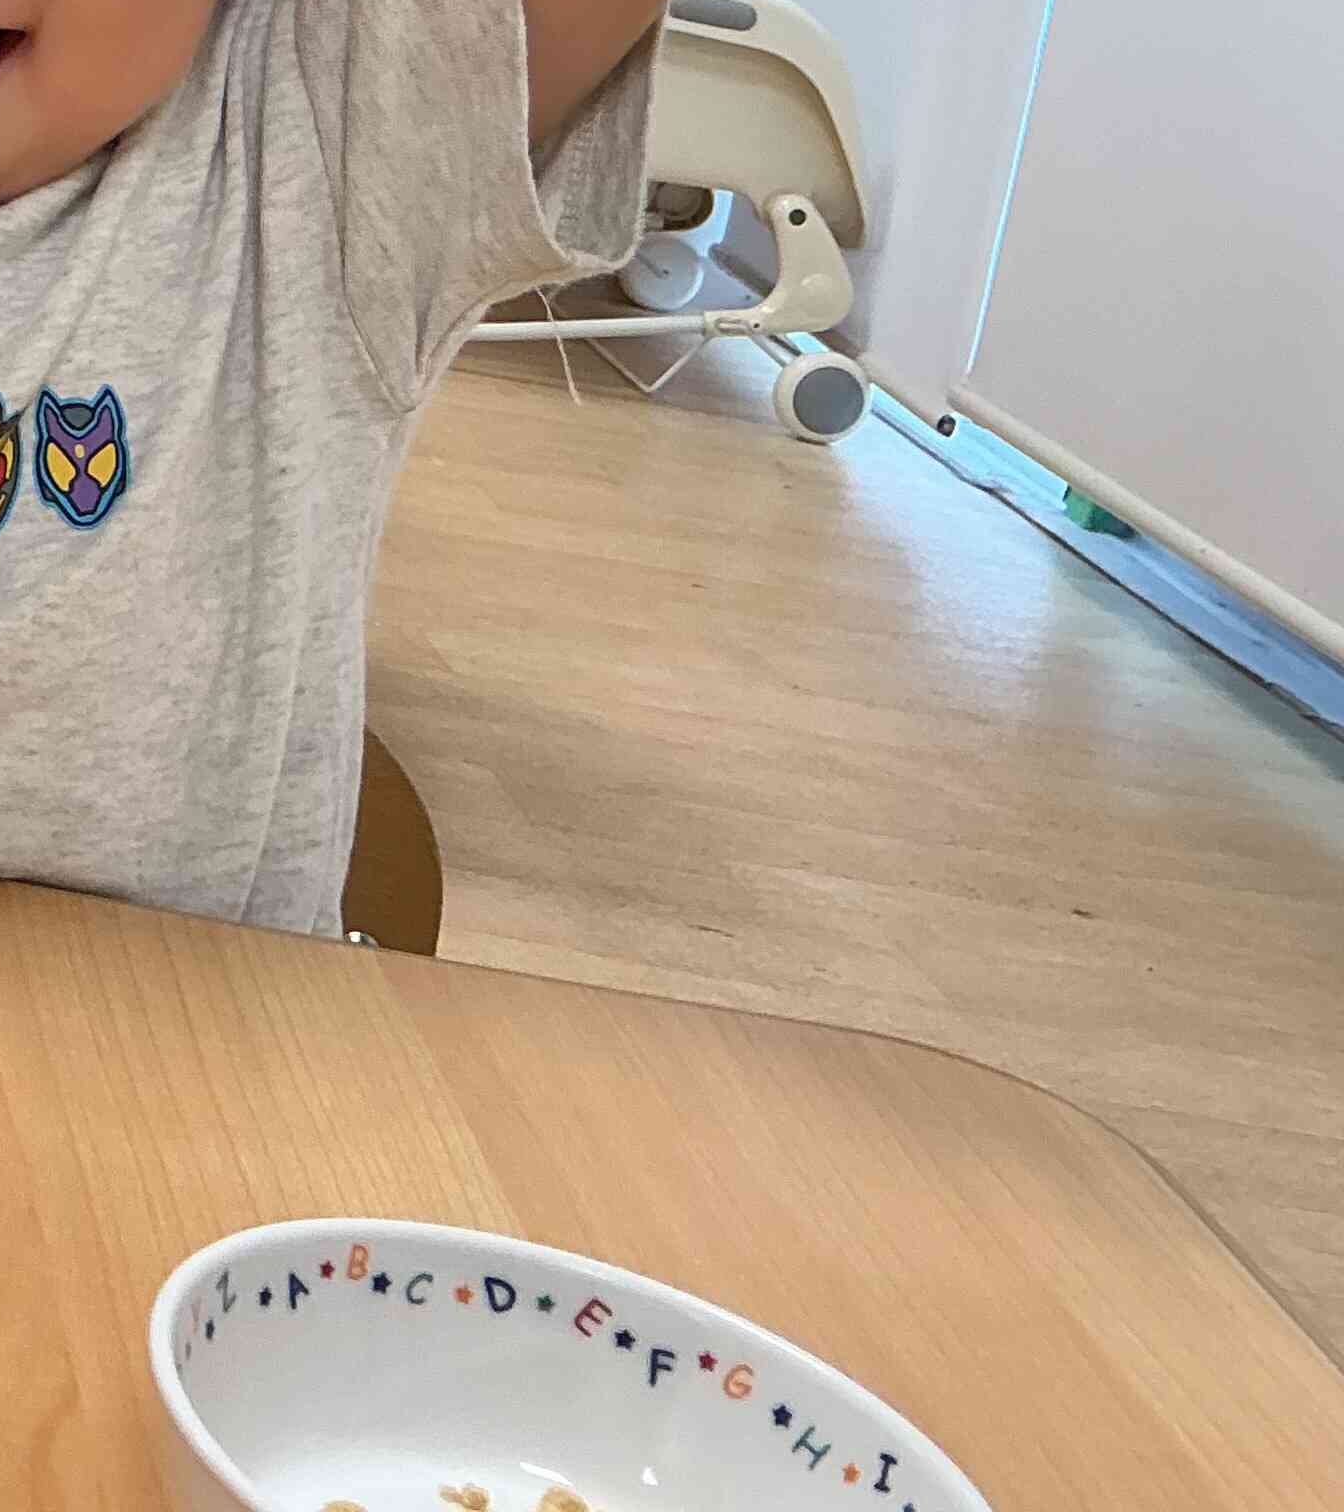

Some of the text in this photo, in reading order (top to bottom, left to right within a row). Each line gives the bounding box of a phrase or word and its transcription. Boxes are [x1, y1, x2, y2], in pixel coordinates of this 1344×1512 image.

[288, 1271, 311, 1310] A
[346, 1243, 370, 1281] B
[406, 1272, 434, 1306] C
[483, 1275, 517, 1313] D
[573, 1298, 614, 1338] E
[647, 1348, 676, 1388] F
[722, 1363, 754, 1401] G
[791, 1426, 832, 1471] H
[873, 1452, 898, 1494] I
